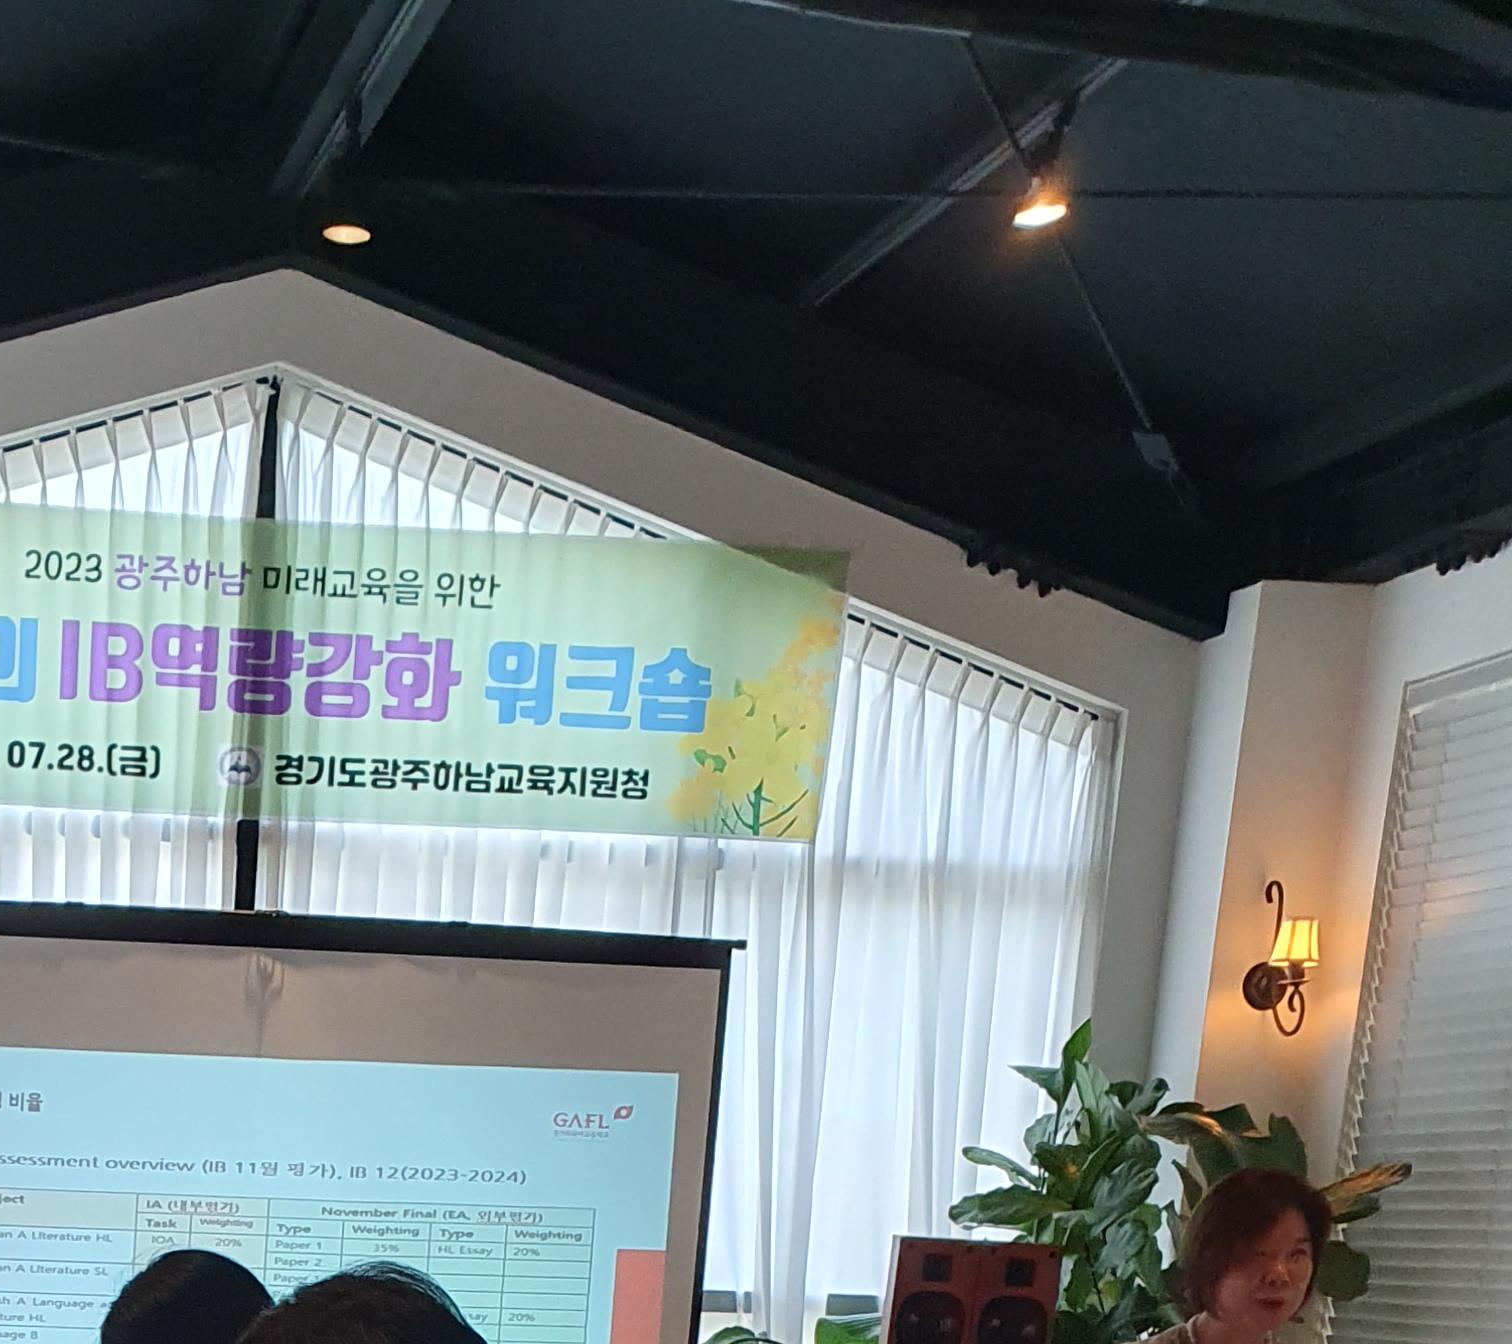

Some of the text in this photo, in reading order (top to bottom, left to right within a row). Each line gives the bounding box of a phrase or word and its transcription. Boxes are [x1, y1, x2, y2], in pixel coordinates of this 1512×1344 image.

[25, 548, 501, 609] 2023 광주하남 미래교육을 위한
[59, 617, 462, 722] IB역량강화
[484, 640, 713, 733] 워크숍
[7, 740, 161, 779] 07.28.(금)
[274, 753, 650, 800] 경기도광주하남교육지원청
[9, 1091, 43, 1112] 비율
[553, 1112, 610, 1129] GAFL
[105, 1157, 194, 1172] overview
[202, 1159, 226, 1174] (IB
[236, 1161, 278, 1177] 11월
[350, 1166, 367, 1179] IB
[375, 1166, 527, 1186] 12(2023-2024)
[146, 1199, 162, 1209] IA
[321, 1206, 397, 1218] November
[402, 1203, 437, 1219] Final
[145, 1219, 177, 1229] Task
[199, 1218, 254, 1230] Weighting
[276, 1223, 312, 1236] Type
[17, 1230, 28, 1240] A
[32, 1230, 91, 1243] Literature
[95, 1233, 112, 1243] HL
[351, 1224, 420, 1238] Weighting
[439, 1228, 474, 1241] Type
[514, 1229, 583, 1242] Weighting
[274, 1240, 322, 1252] Paper 1
[438, 1245, 494, 1258] HL Essay
[513, 1246, 541, 1257] 20%
[274, 1256, 310, 1268] Paper
[15, 1264, 26, 1274] A
[30, 1264, 90, 1276] Literature
[94, 1266, 109, 1277] SL
[16, 1297, 26, 1306] A
[32, 1297, 94, 1310] Language
[29, 1312, 46, 1323] HL
[508, 1311, 536, 1323] 20%
